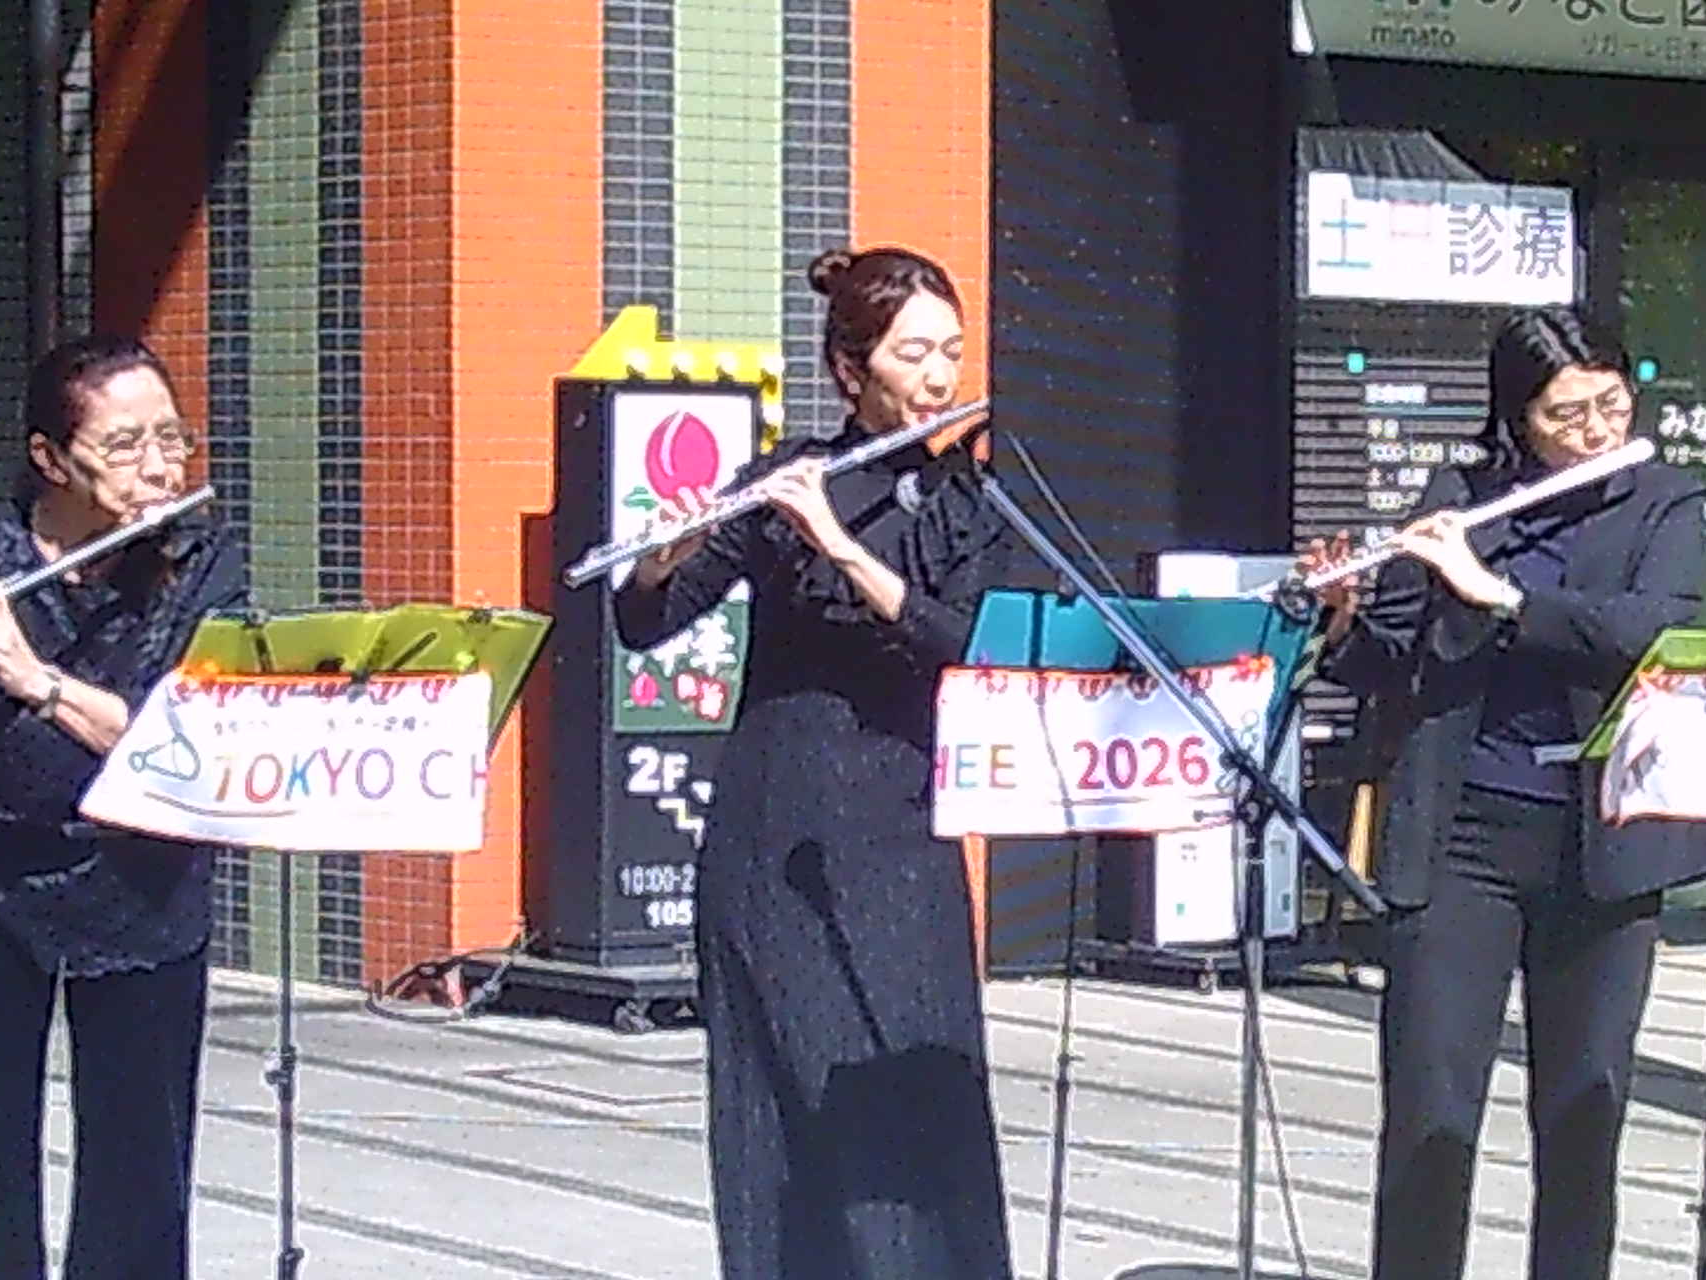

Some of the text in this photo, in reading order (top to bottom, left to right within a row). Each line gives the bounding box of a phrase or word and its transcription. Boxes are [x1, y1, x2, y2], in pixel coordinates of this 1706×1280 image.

[1371, 22, 1455, 49] minato
[214, 746, 395, 804] TOKYO
[627, 745, 690, 794] 2F
[1072, 736, 1211, 790] 2026
